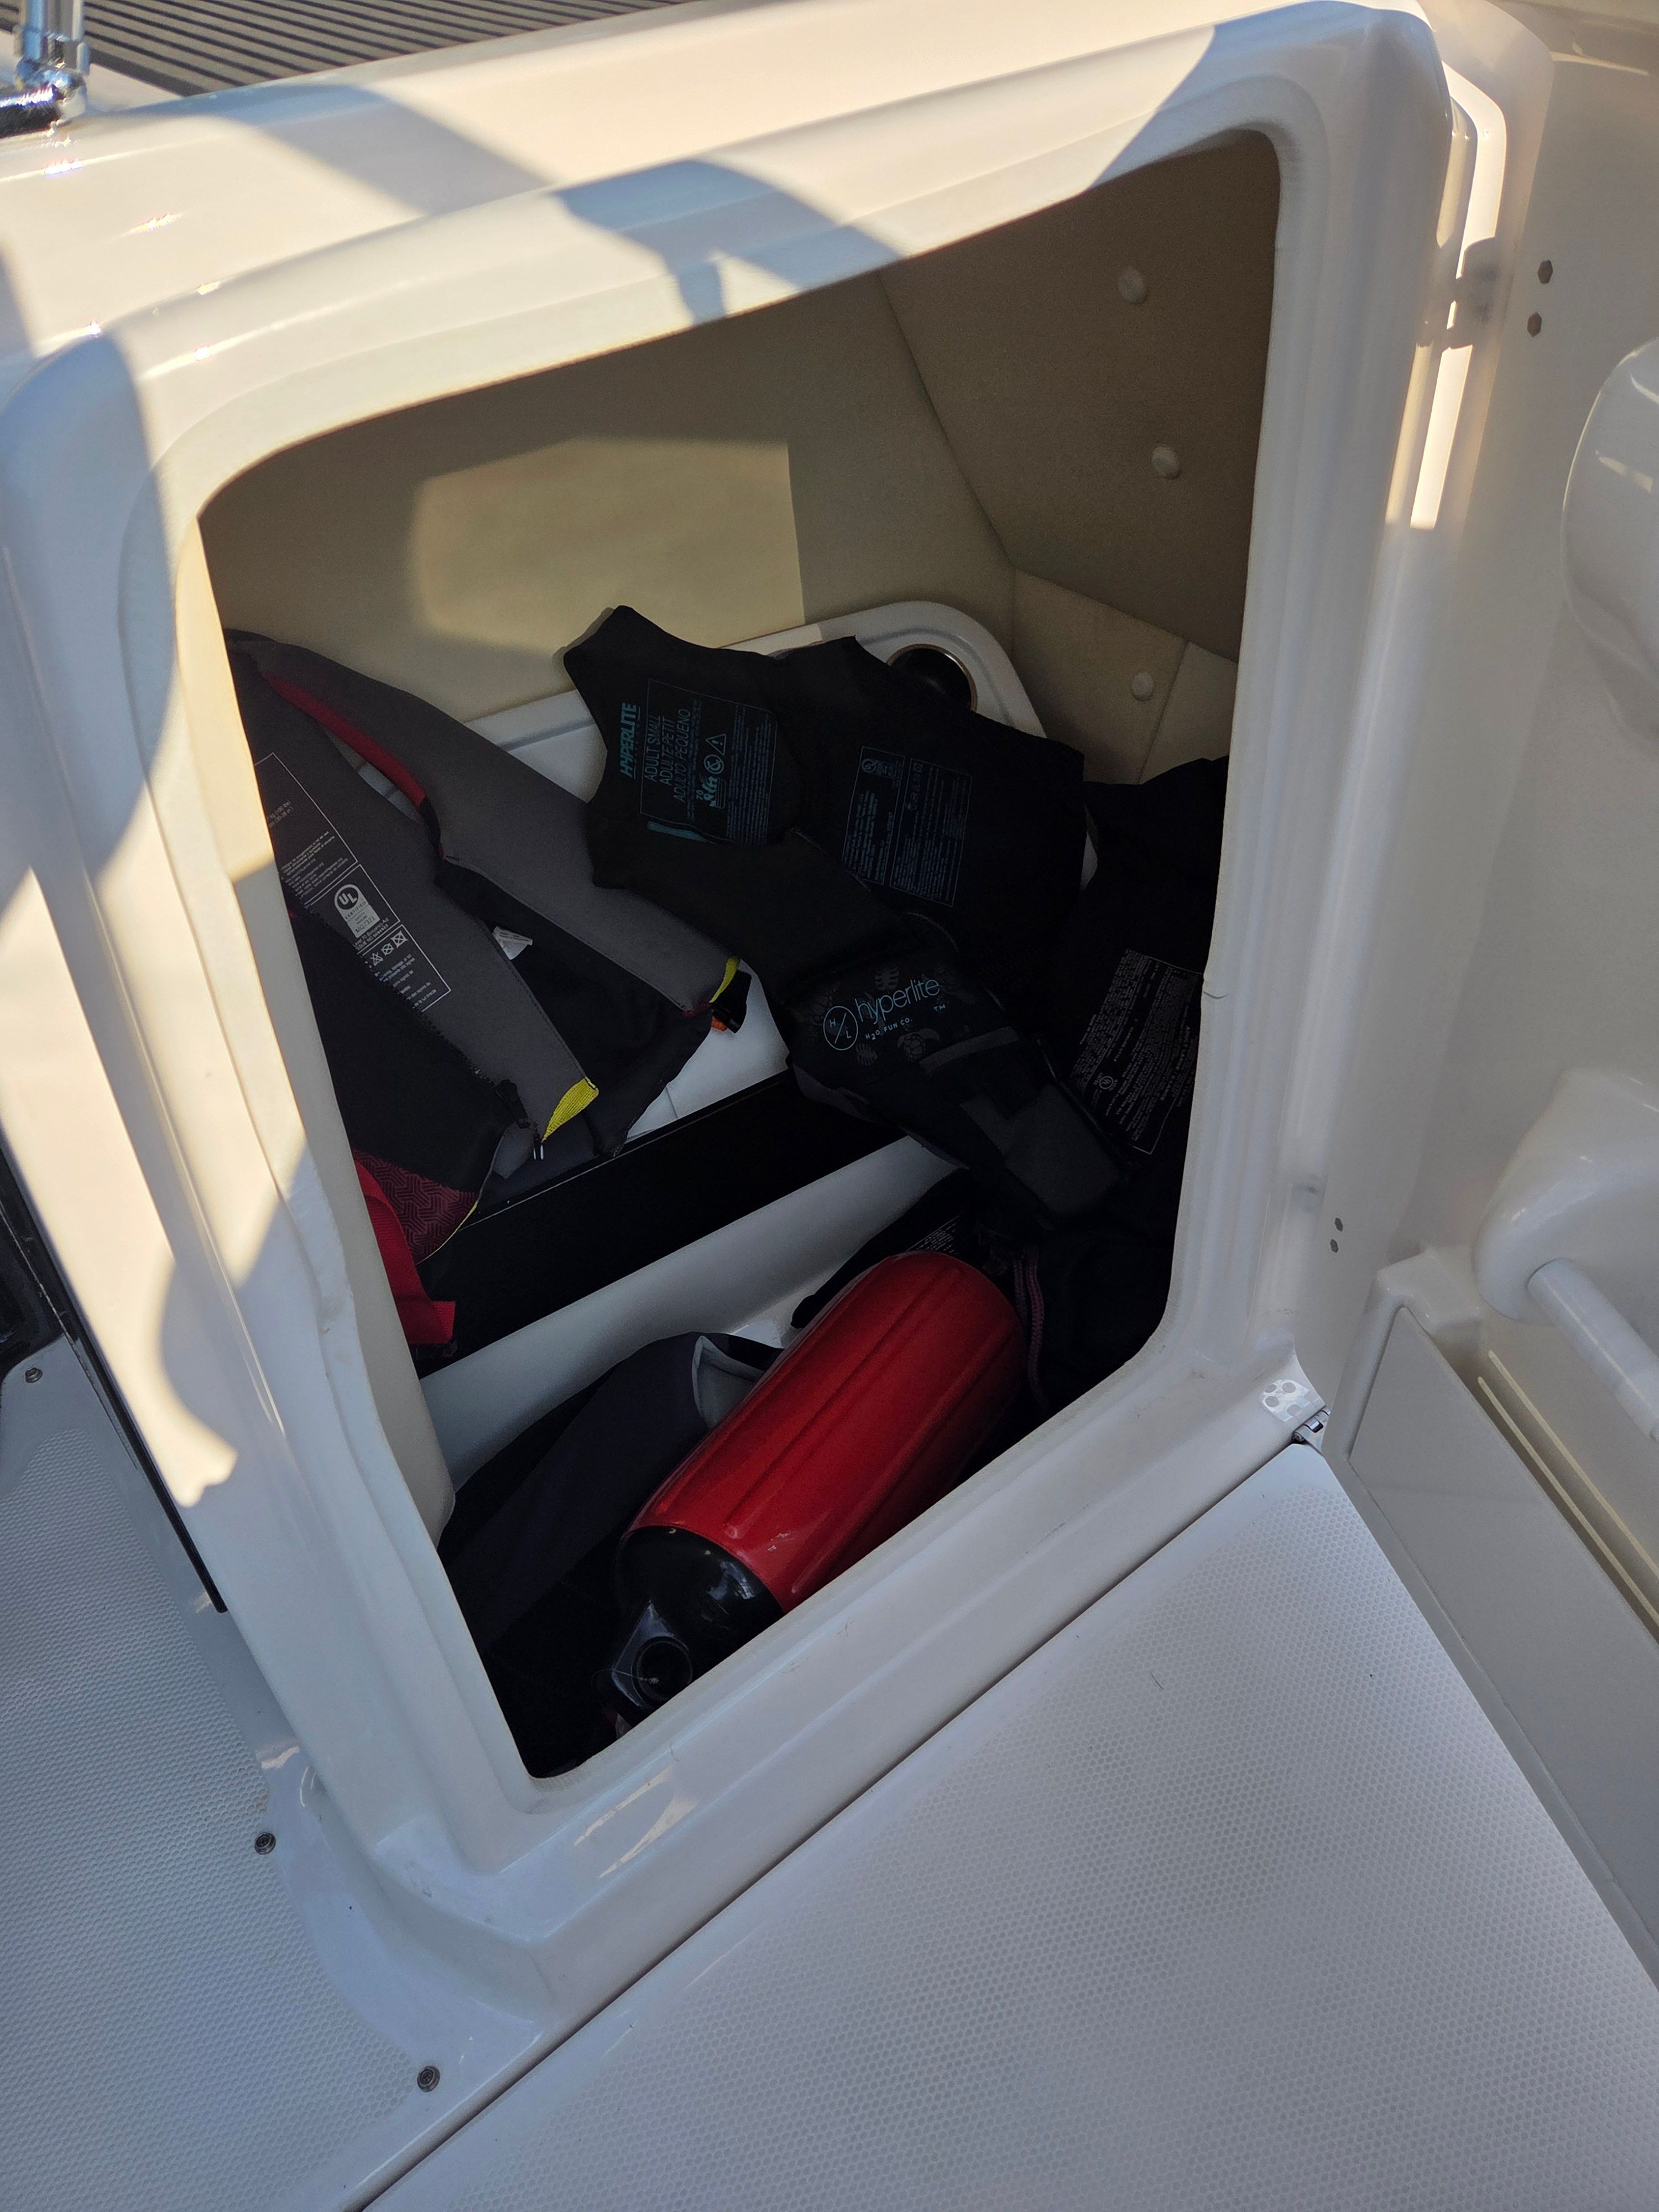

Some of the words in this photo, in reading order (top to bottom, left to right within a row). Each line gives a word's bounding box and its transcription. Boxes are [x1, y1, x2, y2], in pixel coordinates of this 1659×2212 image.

[619, 703, 637, 779] HYPERLITE
[648, 715, 661, 744] SMALL
[662, 716, 675, 747] PETIT
[644, 747, 659, 782] ADULT
[659, 744, 674, 785] ADULTE
[673, 763, 686, 803] ADULTO
[338, 893, 357, 905] UL
[854, 979, 940, 1025] hyperlite
[933, 1004, 946, 1012] TM
[865, 1029, 880, 1040] H2O
[884, 1022, 898, 1032] FUN
[900, 1017, 913, 1025] CO.
